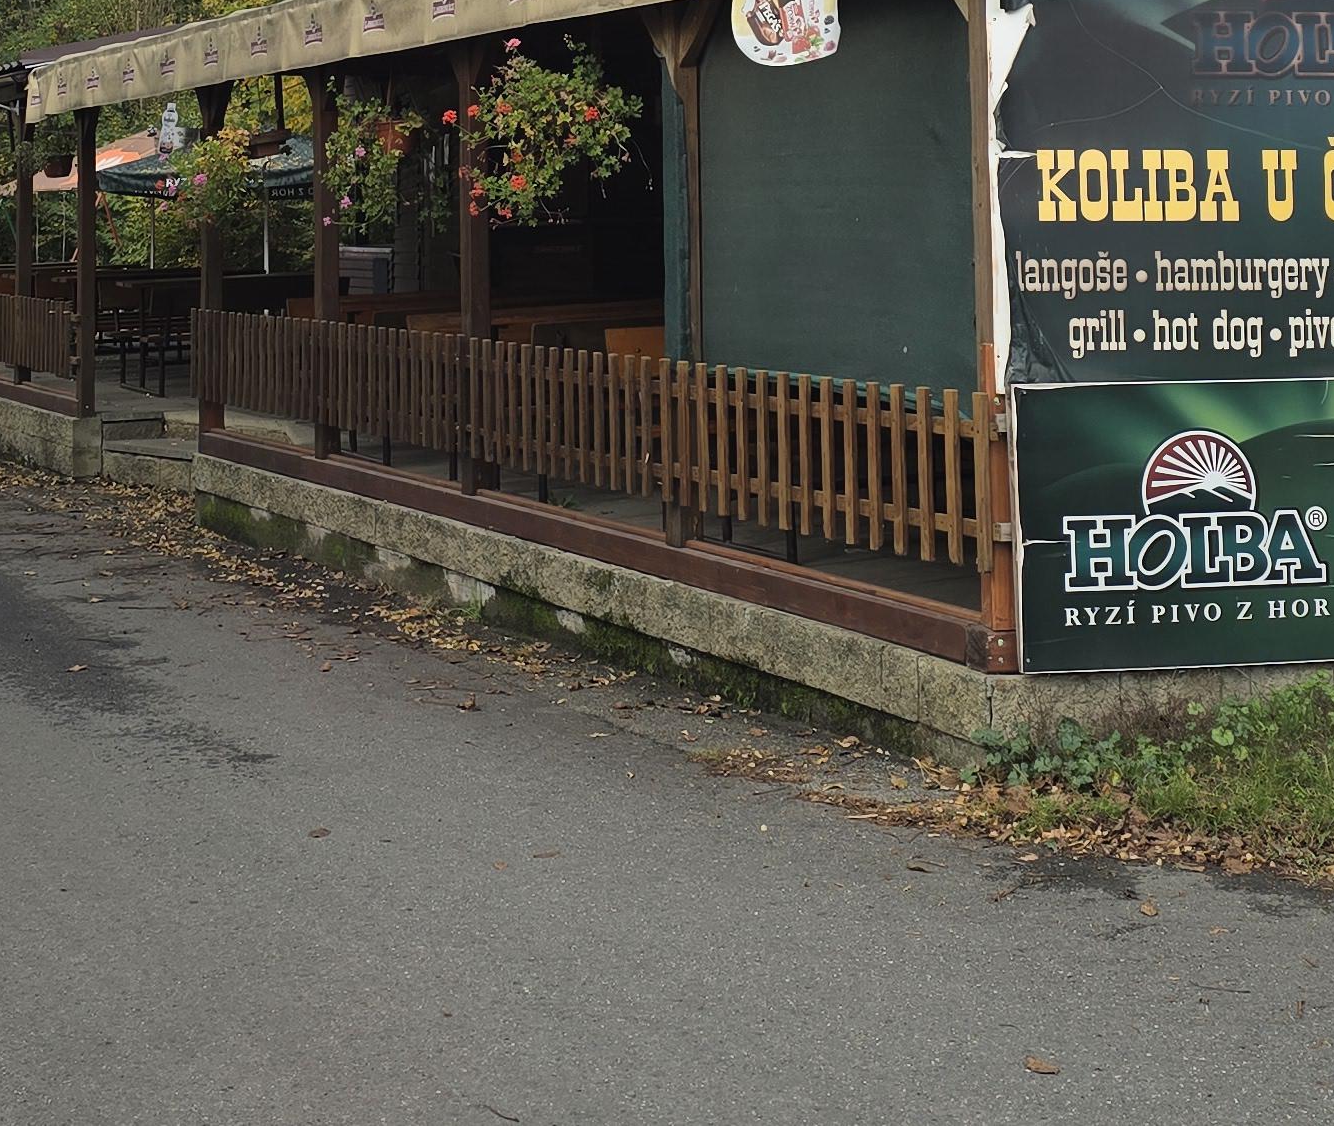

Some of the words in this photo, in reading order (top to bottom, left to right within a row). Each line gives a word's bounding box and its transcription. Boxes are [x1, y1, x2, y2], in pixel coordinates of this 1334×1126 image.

[1193, 86, 1255, 106] RYZÍ
[1269, 89, 1331, 106] PIVO
[1036, 148, 1240, 222] KOLIBA
[1262, 149, 1297, 222] U
[1015, 251, 1128, 299] langoše
[1155, 251, 1330, 298] hamburgery
[1069, 309, 1127, 359] grill
[1153, 309, 1199, 351] hot
[1212, 310, 1264, 357] dog
[1063, 510, 1327, 592] HOLBA
[1064, 600, 1136, 626] RYZÍ
[1151, 601, 1223, 624] PIVO
[1237, 600, 1254, 621] Z
[1269, 597, 1331, 620] HOR
